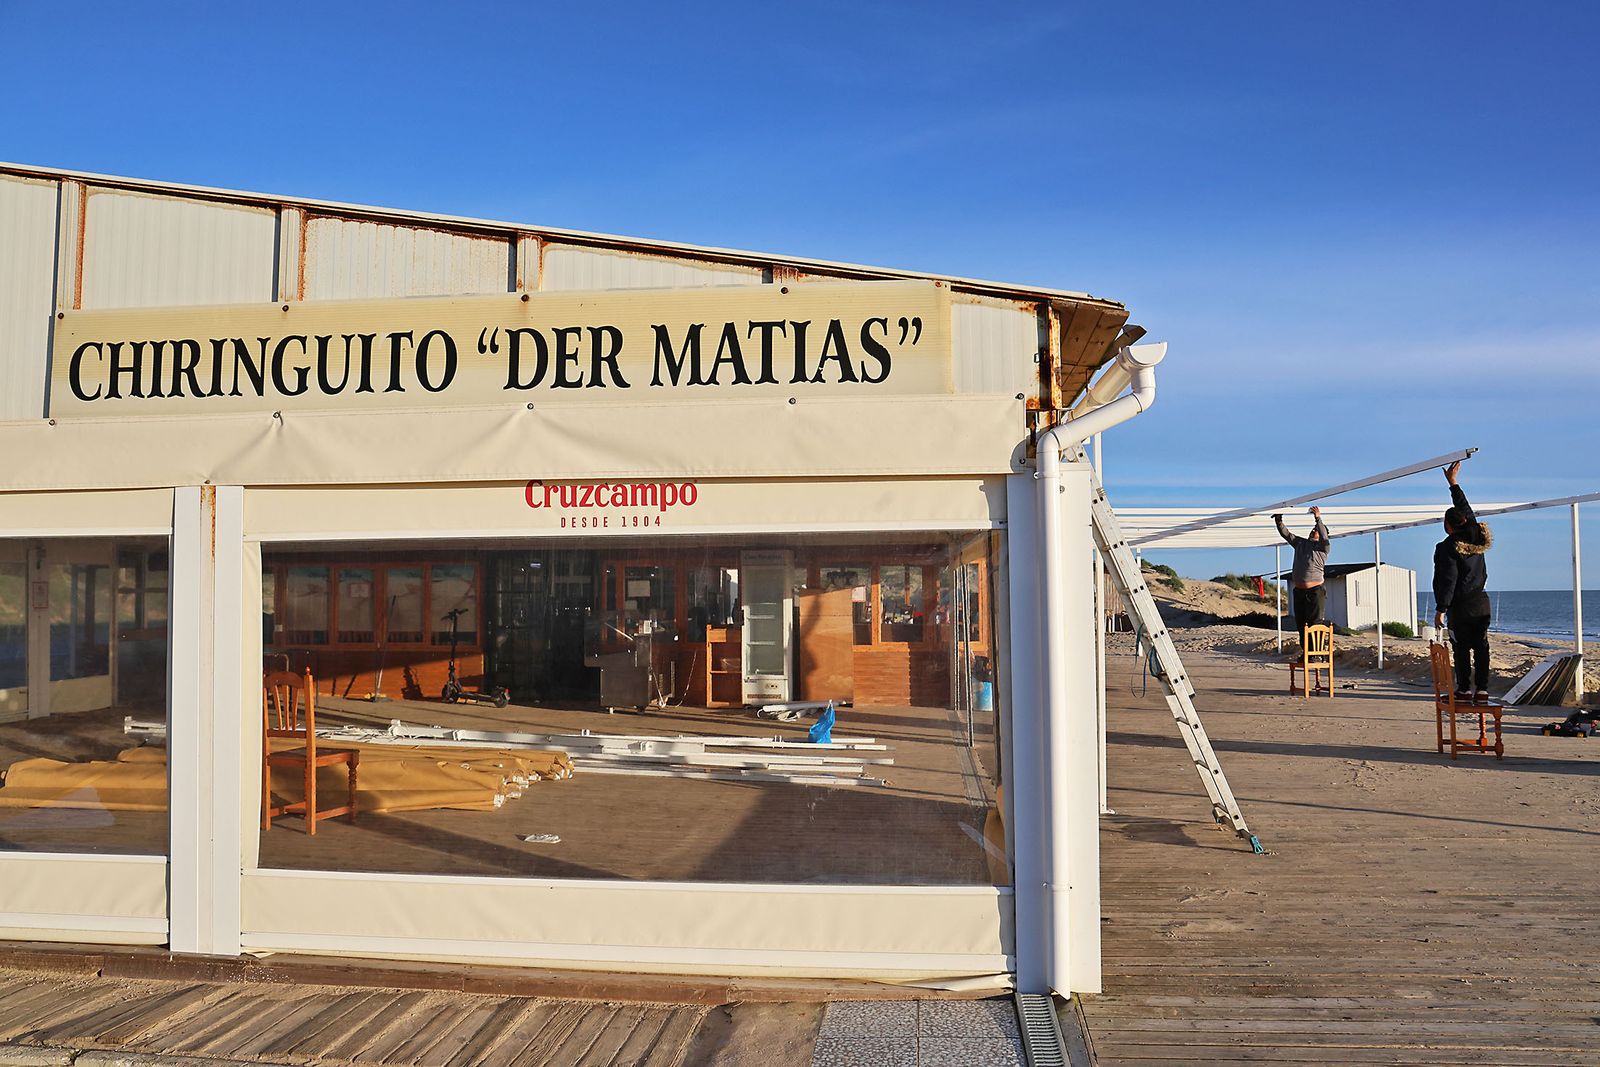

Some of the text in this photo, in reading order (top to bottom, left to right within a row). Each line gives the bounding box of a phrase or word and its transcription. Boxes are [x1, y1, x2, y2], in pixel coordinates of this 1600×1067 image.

[69, 317, 923, 401] CHIRINGUITO “DER MATIAS”
[525, 479, 698, 512] Cruzcampo
[560, 515, 661, 528] DESDE 1904
